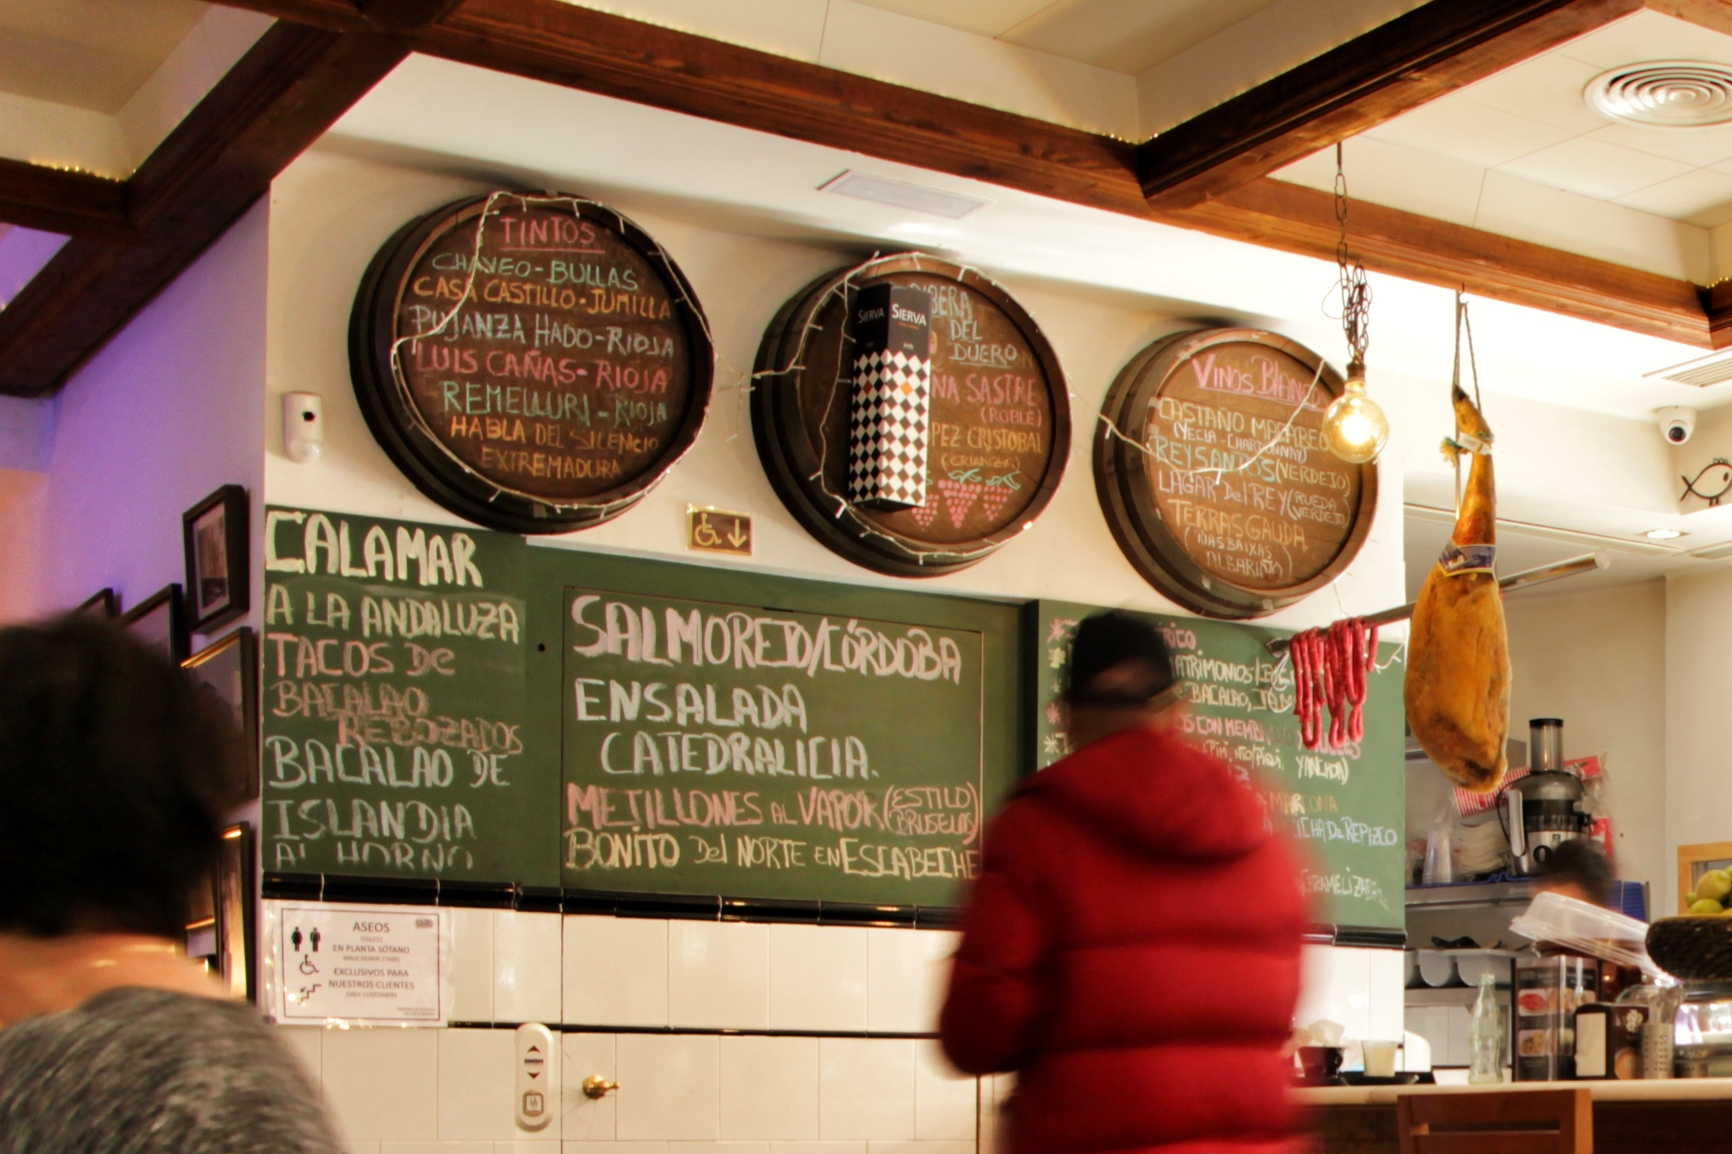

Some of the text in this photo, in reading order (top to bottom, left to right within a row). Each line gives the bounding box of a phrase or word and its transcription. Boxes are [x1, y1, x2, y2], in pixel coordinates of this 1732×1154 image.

[501, 217, 596, 246] TINTOS
[414, 276, 477, 303] CASA
[549, 261, 639, 291] BULLAS
[410, 305, 527, 344] PUJANZA
[892, 304, 927, 327] SIERVA
[951, 320, 983, 343] DEL
[416, 343, 478, 372] LUIS
[949, 344, 1018, 365] DUERO
[965, 373, 1038, 406] SASTRE
[451, 416, 526, 445] HABLA
[535, 423, 565, 449] DEL
[981, 407, 1042, 427] (ROBLE)
[967, 427, 1043, 454] CRISTOBAL
[481, 448, 621, 480] EXTREMADURA
[1159, 470, 1217, 503] LAGAR
[1249, 482, 1288, 516] REY
[265, 509, 484, 588] CALAMAR
[266, 583, 520, 645] A LA ANDALUZA
[267, 633, 395, 679] TACOS
[271, 680, 429, 720] BACALAO
[574, 678, 808, 734] ENSALADA
[336, 713, 523, 755] REBOZADOS
[1196, 715, 1223, 737] CON
[265, 735, 511, 789] BACALAO DE
[267, 798, 478, 843] ISLANDIA
[770, 801, 798, 827] AL
[797, 785, 885, 832] VAPOR
[736, 834, 808, 868] NORTE
[840, 837, 979, 881] ESCABECHE
[353, 922, 391, 933] ASEOS
[346, 945, 376, 953] PLANTA
[378, 945, 410, 954] SÓTANO
[328, 980, 415, 990] NUESTROS CLIENTES
[334, 968, 409, 977] EXCLUSIVOS PARA
